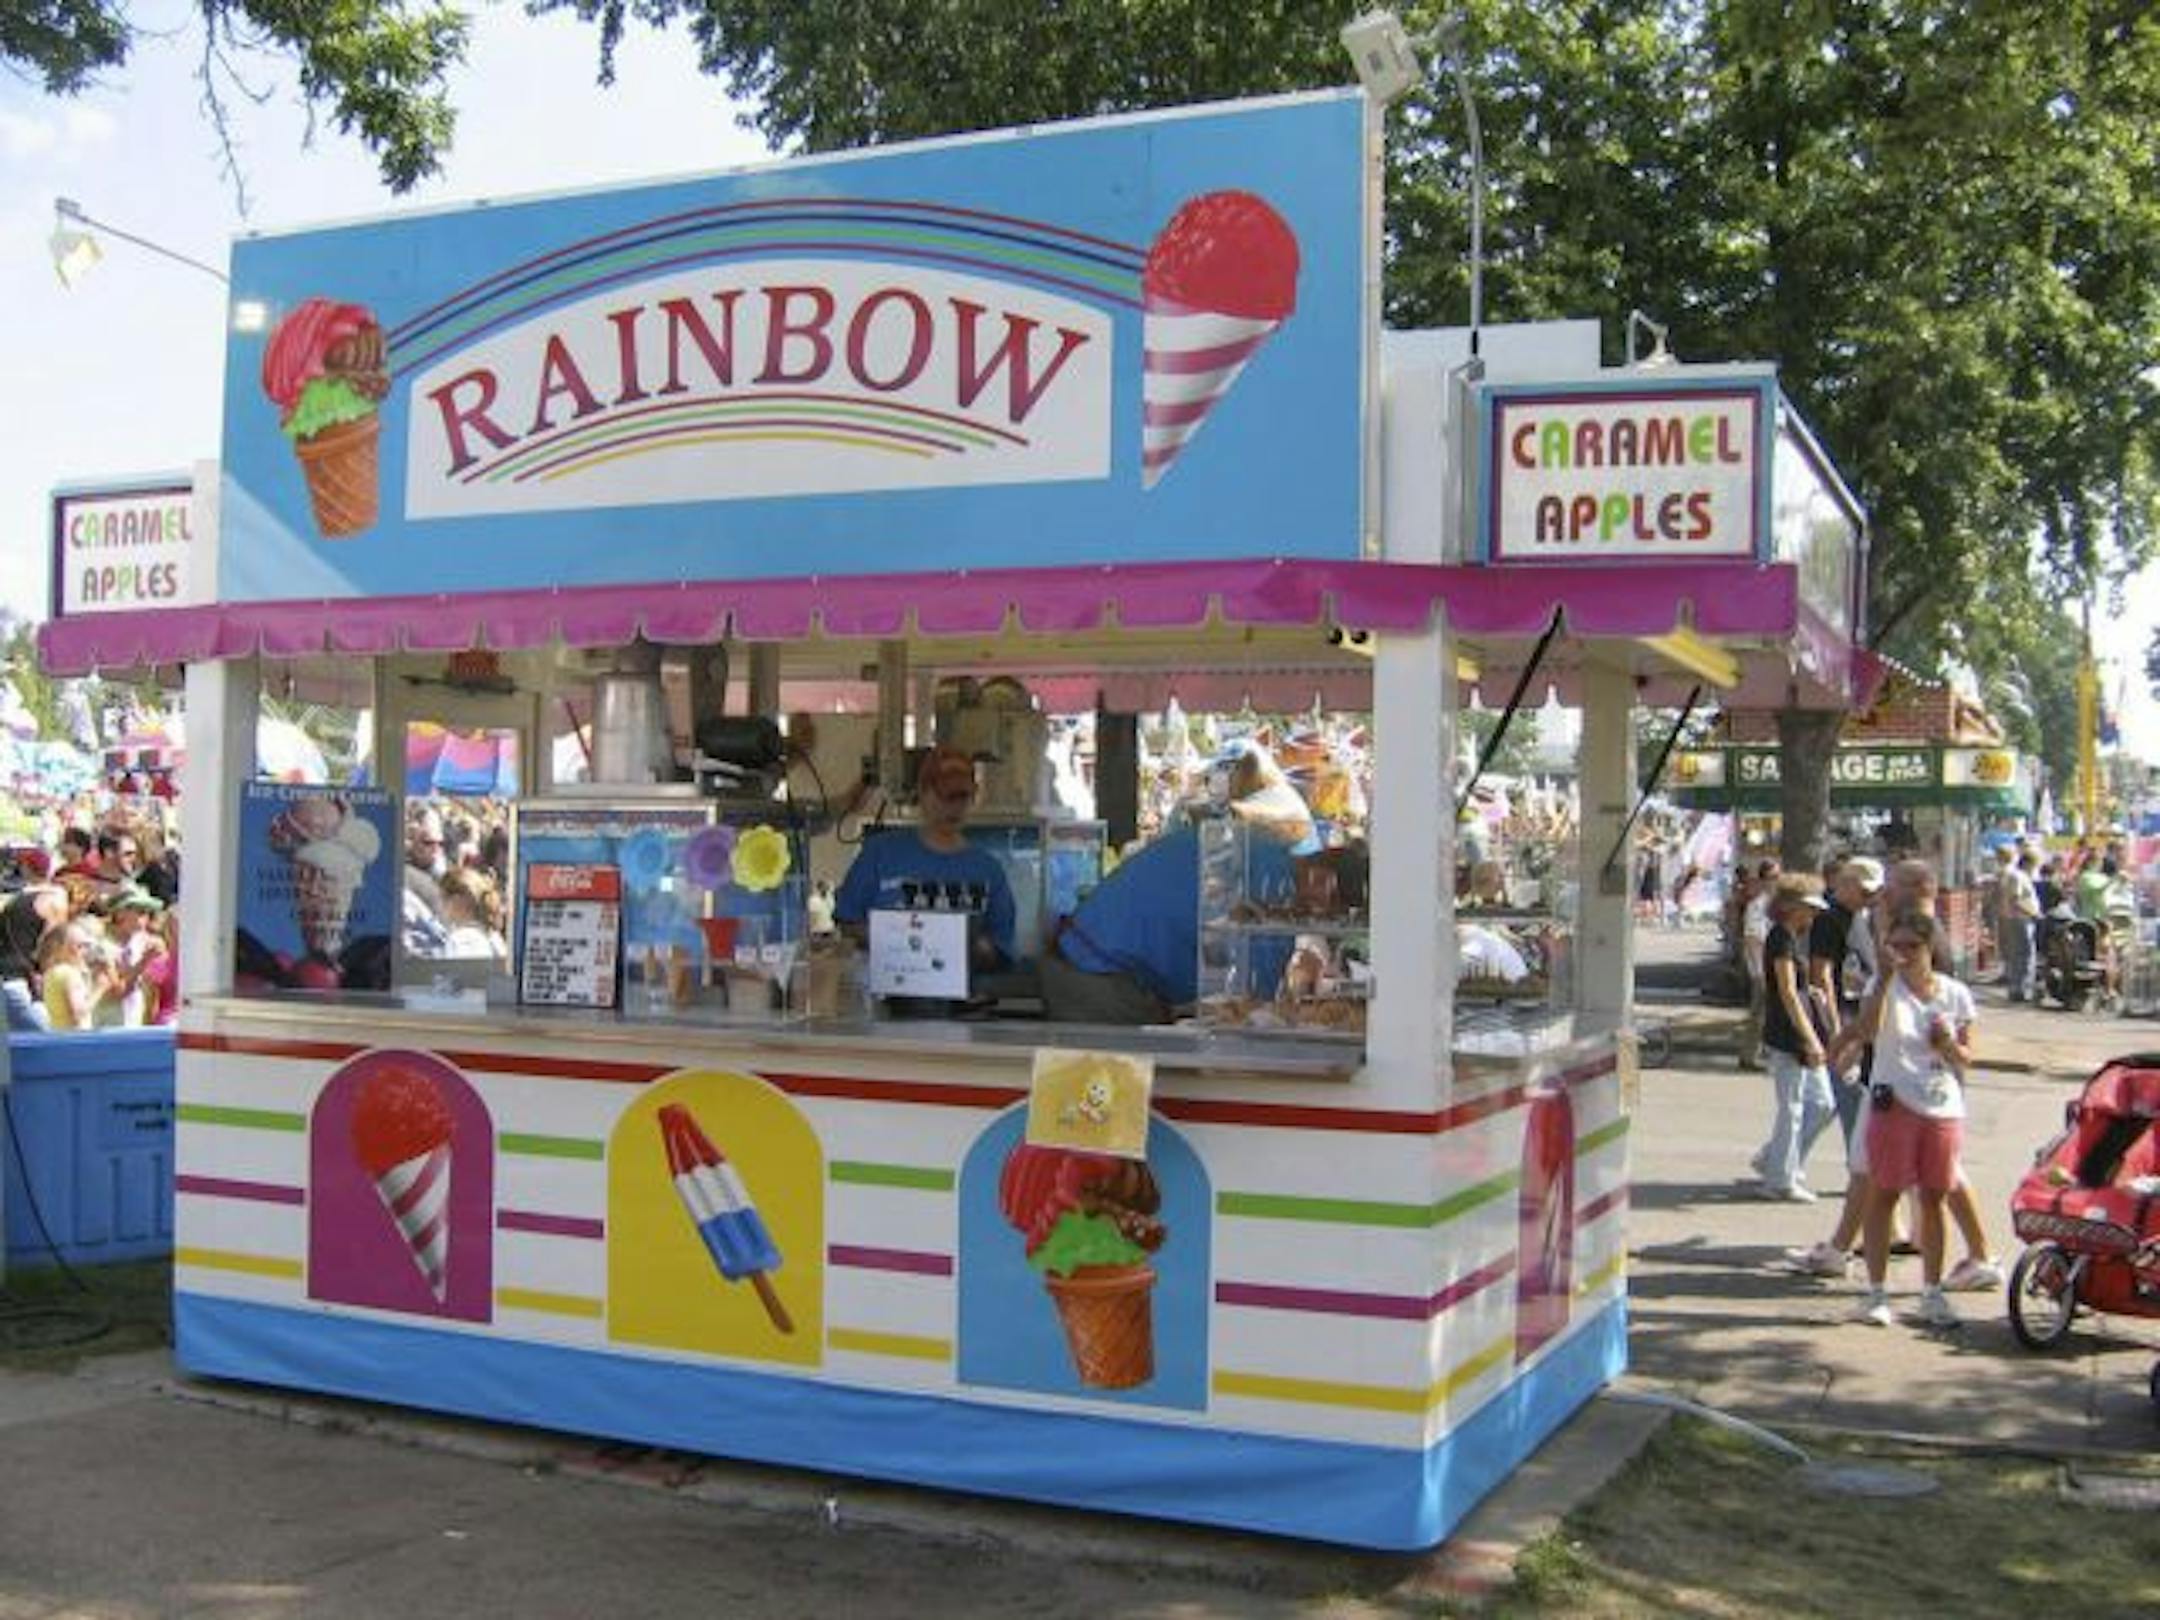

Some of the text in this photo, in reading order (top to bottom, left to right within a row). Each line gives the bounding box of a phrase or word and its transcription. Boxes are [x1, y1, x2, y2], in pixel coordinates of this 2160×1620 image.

[426, 285, 1090, 477] RAINBOW
[1511, 415, 1742, 470] CARAMEL
[70, 506, 192, 549] CARAMEL
[1535, 492, 1713, 543] APPLES
[81, 562, 177, 603] APPLES
[1739, 753, 1885, 782] SAAGE
